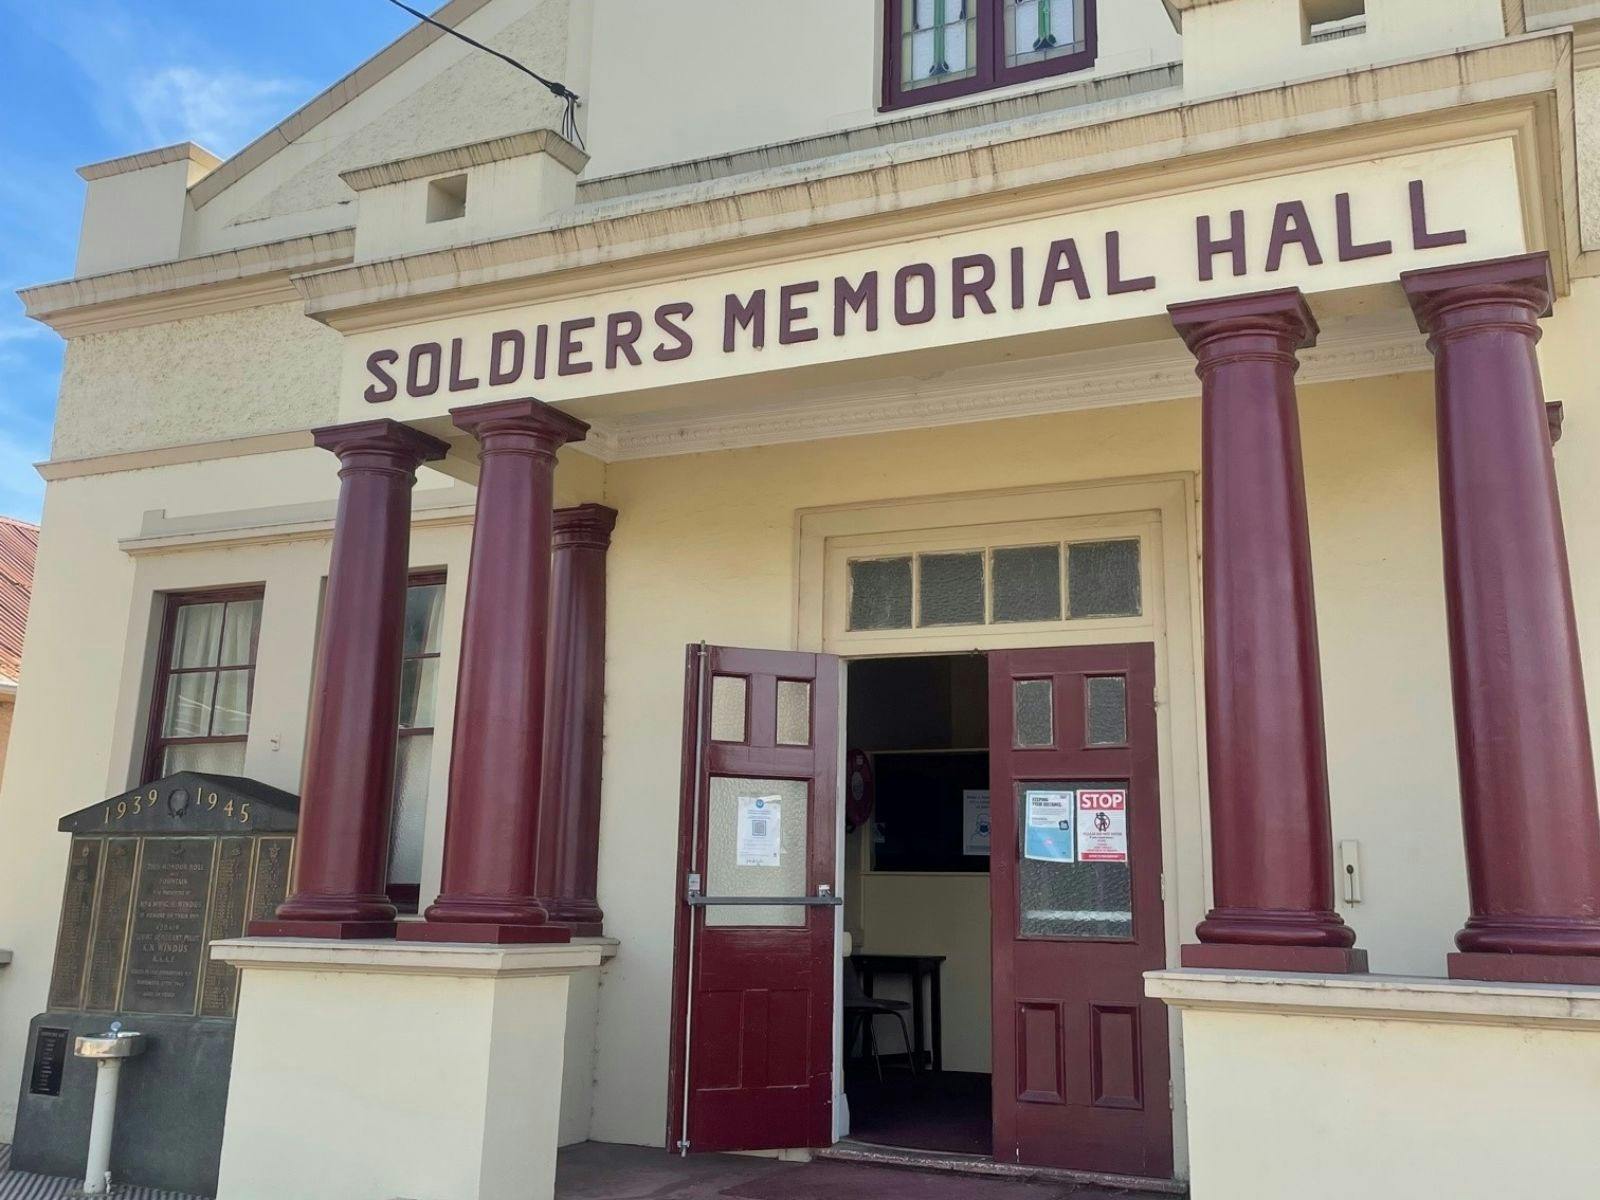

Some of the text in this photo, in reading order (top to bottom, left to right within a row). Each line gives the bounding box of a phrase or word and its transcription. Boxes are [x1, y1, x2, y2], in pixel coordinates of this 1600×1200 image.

[363, 179, 1467, 404] SOLDIERS MEMORIAL HALL
[104, 787, 249, 825] 1939 1945
[1081, 793, 1123, 809] STOP
